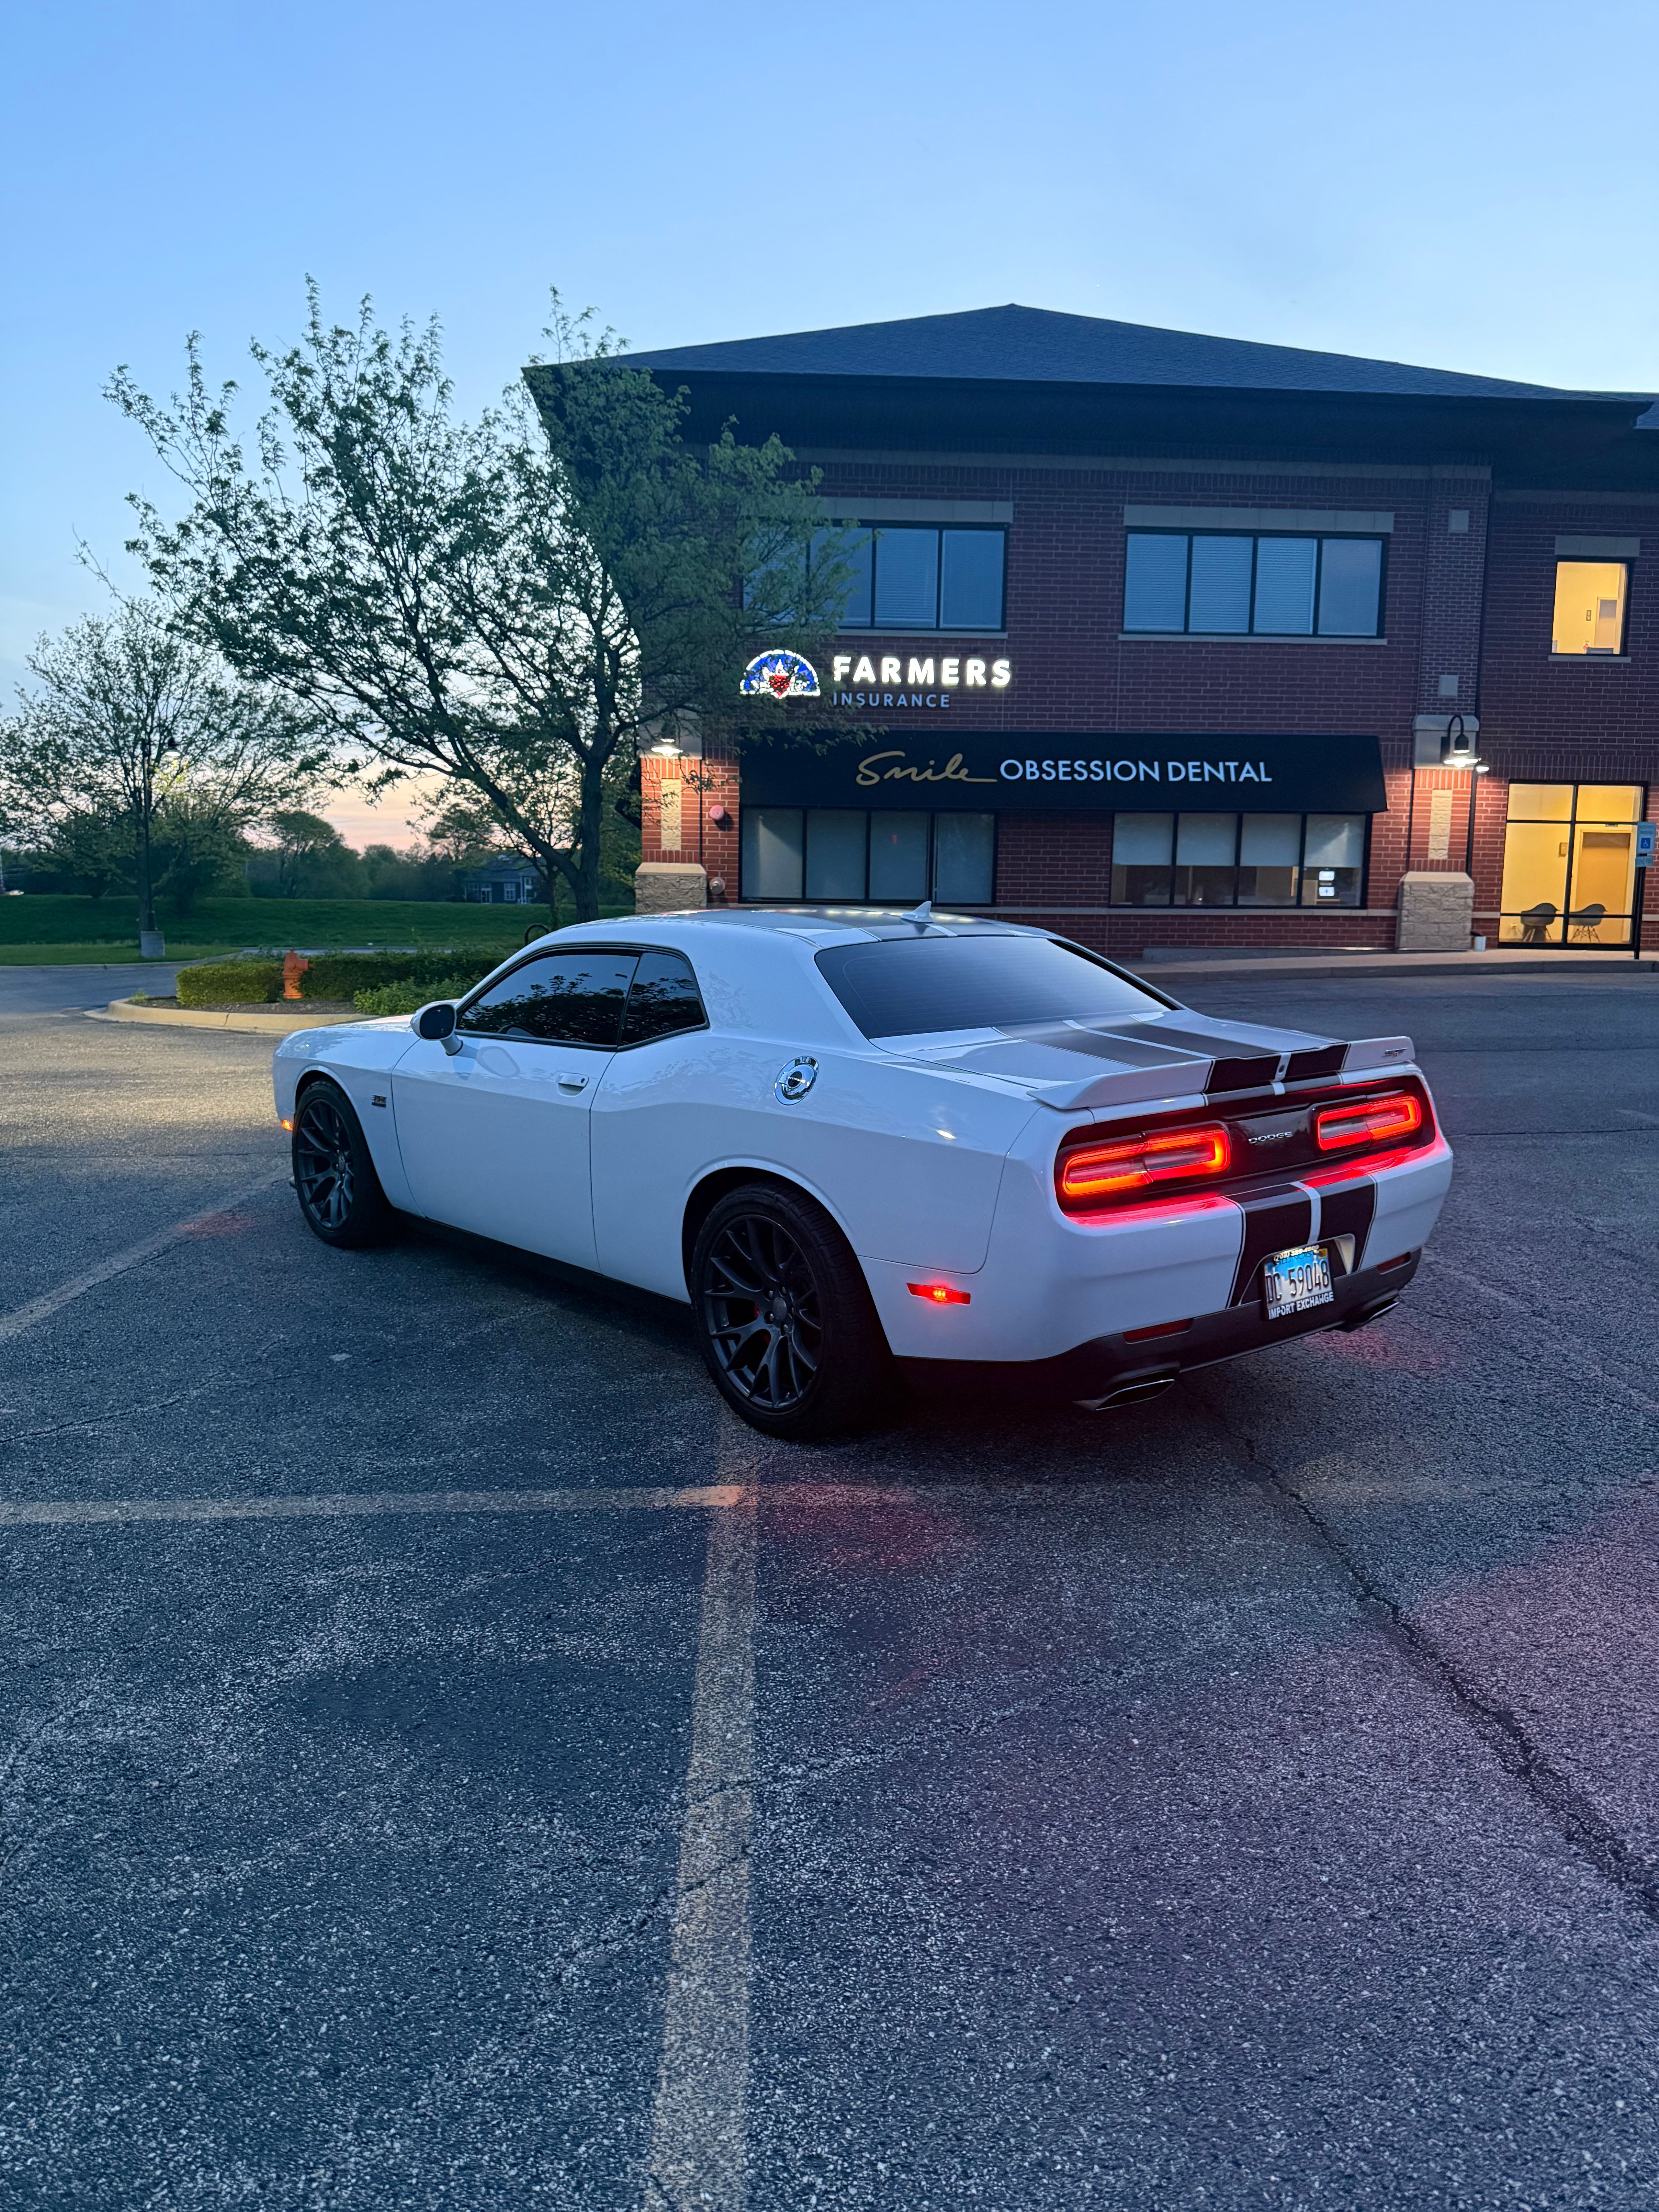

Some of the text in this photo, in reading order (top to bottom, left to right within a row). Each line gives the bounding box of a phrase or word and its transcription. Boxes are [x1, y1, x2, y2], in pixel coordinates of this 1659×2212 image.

[833, 656, 1011, 685] FARMERS
[833, 693, 950, 708] INSURANCE
[855, 750, 1273, 786] Smile OBSESSION DENTAL
[1248, 1131, 1293, 1144] DODGE
[1288, 1260, 1329, 1296] 59048
[1268, 1291, 1334, 1320] IMPORT EXCHANGE
